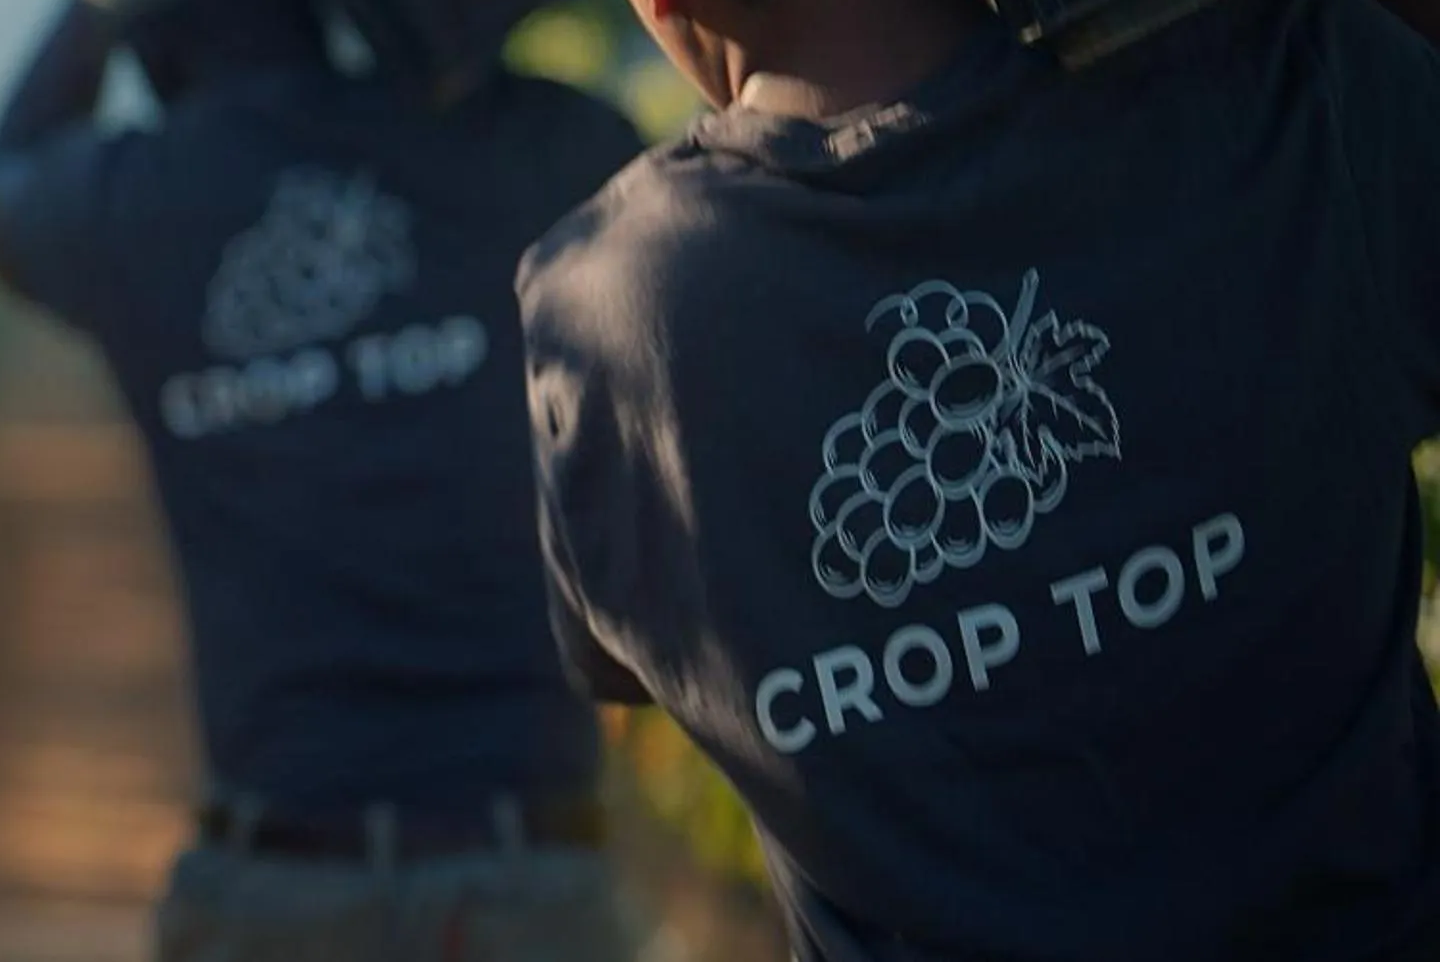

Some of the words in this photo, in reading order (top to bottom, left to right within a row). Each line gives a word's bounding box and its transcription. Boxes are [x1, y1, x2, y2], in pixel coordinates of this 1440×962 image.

[348, 316, 487, 403] TOP
[755, 603, 1021, 754] CROP
[1049, 512, 1246, 656] TOP
